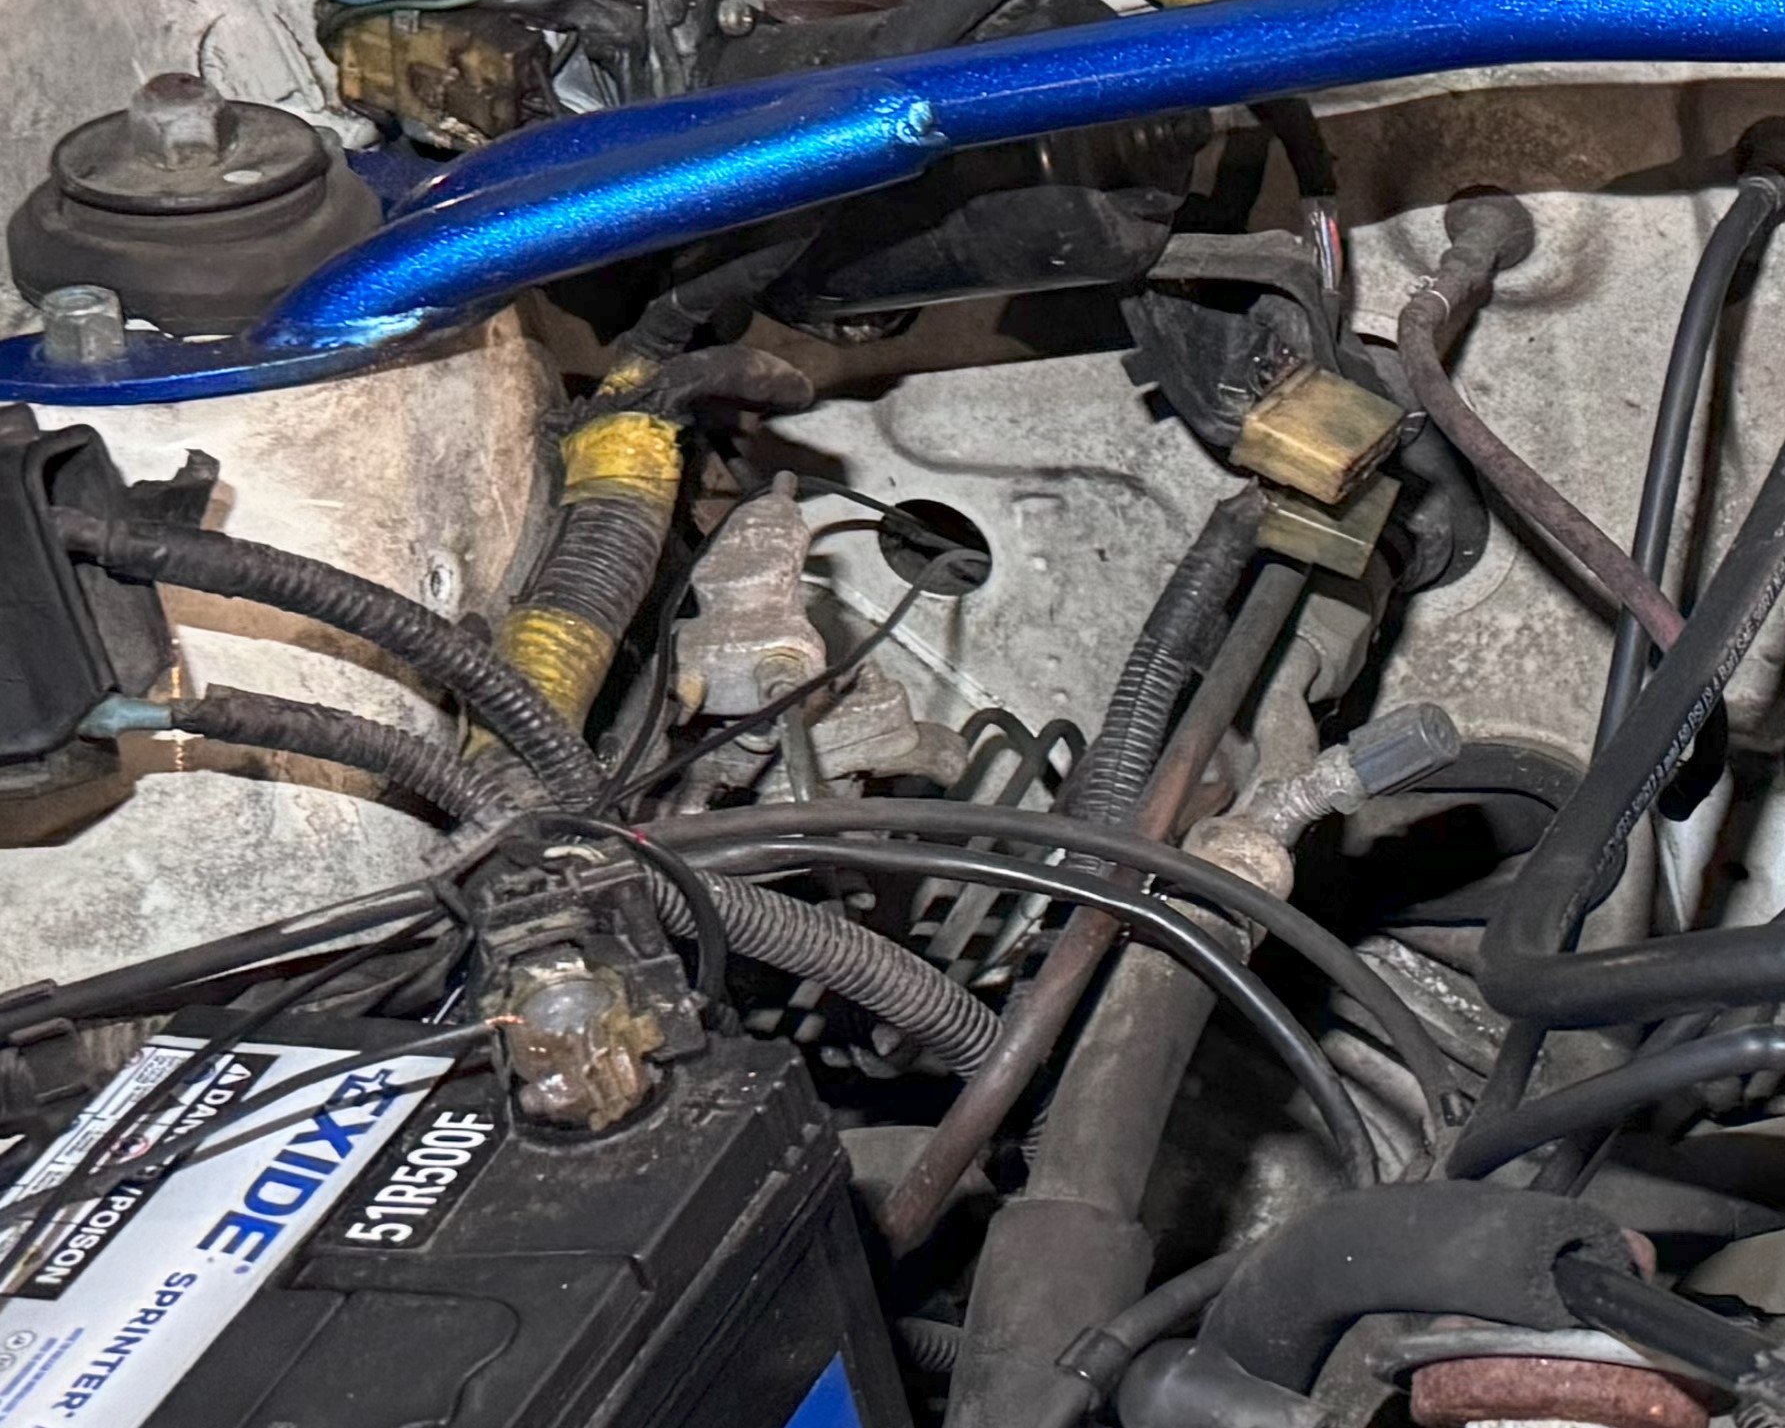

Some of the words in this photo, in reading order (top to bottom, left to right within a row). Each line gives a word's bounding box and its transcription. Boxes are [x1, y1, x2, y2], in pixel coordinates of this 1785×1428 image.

[196, 1068, 394, 1263] EXIDE
[345, 1111, 495, 1243] 51R500F
[52, 1271, 197, 1409] SPRINTER
